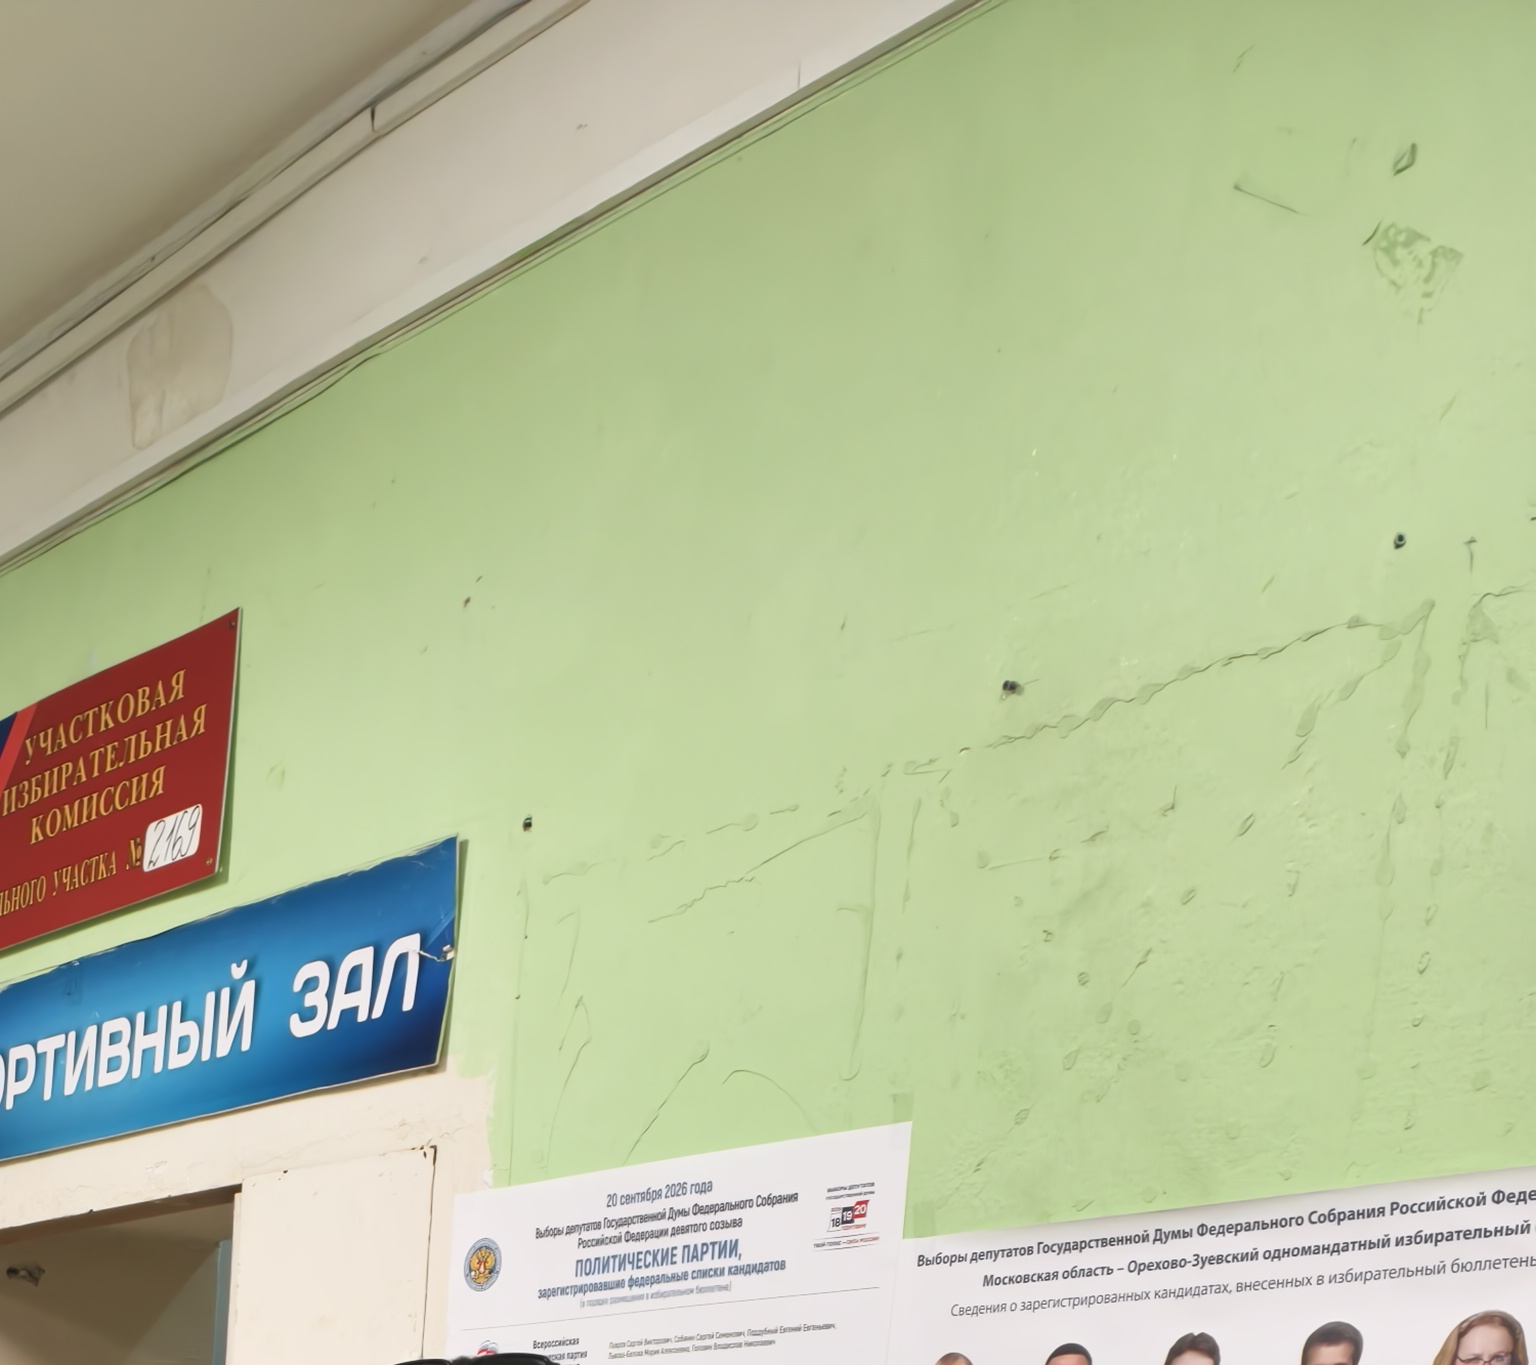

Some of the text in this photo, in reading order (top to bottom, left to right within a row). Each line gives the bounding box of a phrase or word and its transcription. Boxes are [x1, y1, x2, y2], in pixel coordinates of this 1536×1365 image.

[24, 669, 185, 765] УЧАСТКОВАЯ
[2, 705, 207, 816] ИЗБИРАТЕЛЬНАЯ
[30, 766, 166, 845] КОМИССИЯ
[148, 807, 201, 870] 2169
[52, 850, 117, 896] УЧАСТКА
[289, 933, 420, 1038] ЗАЛ
[535, 1192, 798, 1239] Выборы депутатов Государственной Думы Федерального Собрания
[606, 1180, 713, 1208] 20 сентября 2026 года
[843, 1211, 852, 1221] 19
[854, 1204, 866, 1214] 20
[578, 1217, 743, 1249] Российской Федерации девятого созыва
[831, 1217, 840, 1227] 18
[917, 1189, 1536, 1267] Выборы депутатов Государственной Думы Федерального Собрания Российской Феде
[575, 1238, 742, 1277] ПОЛИТИЧЕСКИЕ ПАРТИИ,
[982, 1268, 1059, 1287] Московская
[1061, 1264, 1114, 1281] область
[1127, 1247, 1259, 1275] Орехово-Зуевский
[1263, 1234, 1391, 1261] одномандатный
[1395, 1219, 1531, 1247] избирательный
[538, 1259, 786, 1299] зарегистрировавшие федеральные списки кандидатов
[951, 1255, 1536, 1317] Сведения о зарегистрированных кандидатах, внесенных в избирательный бюллетень
[533, 1337, 579, 1350] Всероссийская
